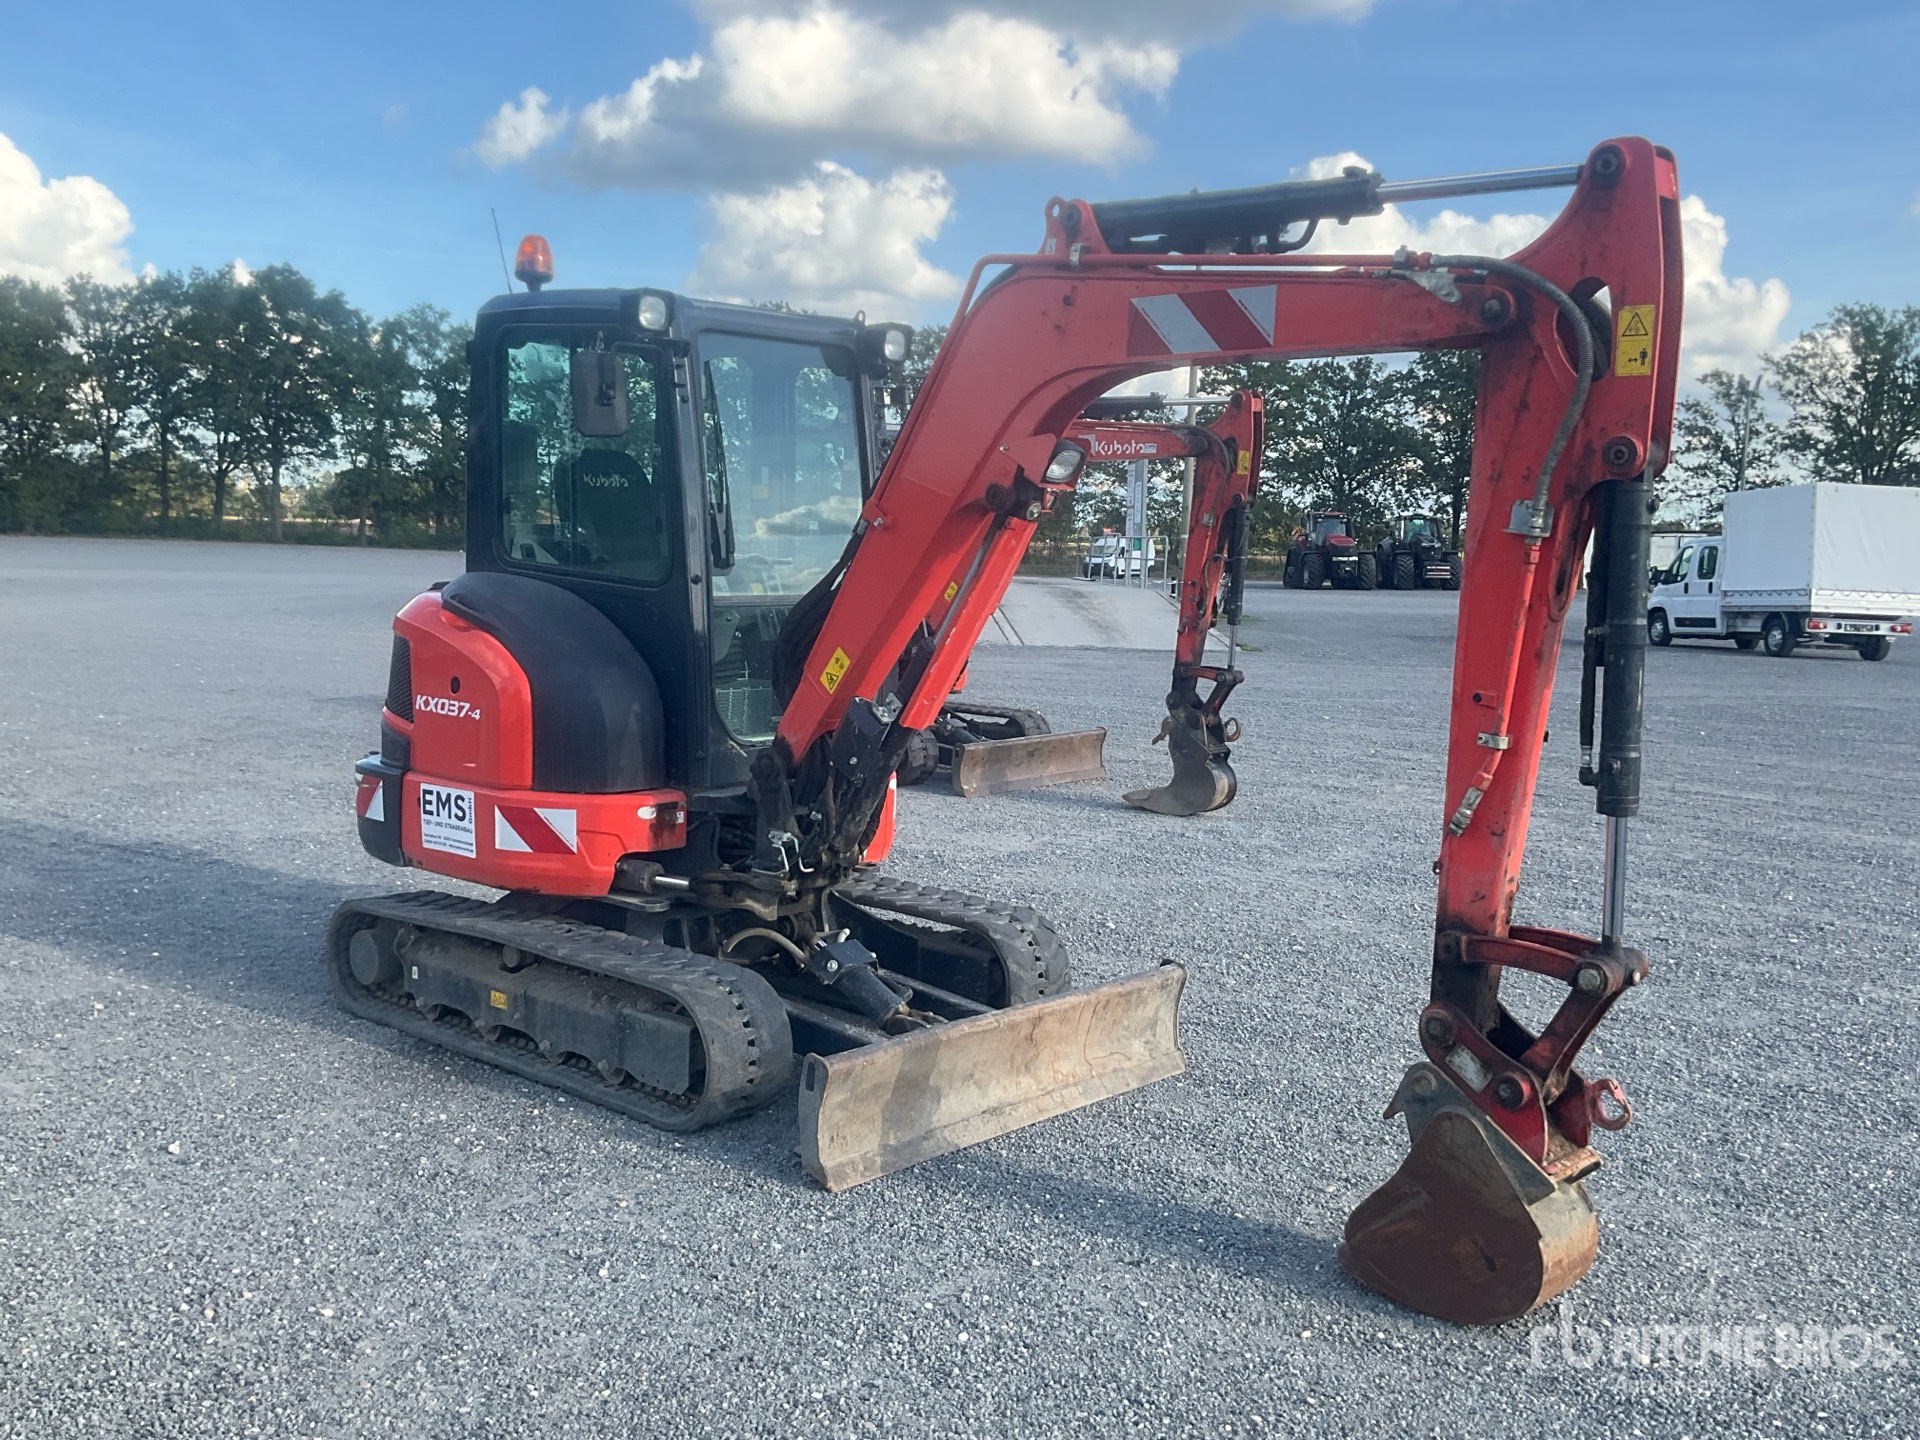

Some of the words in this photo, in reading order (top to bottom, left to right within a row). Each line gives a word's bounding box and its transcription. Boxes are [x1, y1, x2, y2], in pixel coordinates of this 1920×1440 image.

[1095, 440, 1145, 455] Kubota
[583, 473, 629, 487] Kubota
[415, 694, 481, 720] KX037-4
[422, 788, 467, 822] EMS
[423, 818, 434, 826] TIEF-
